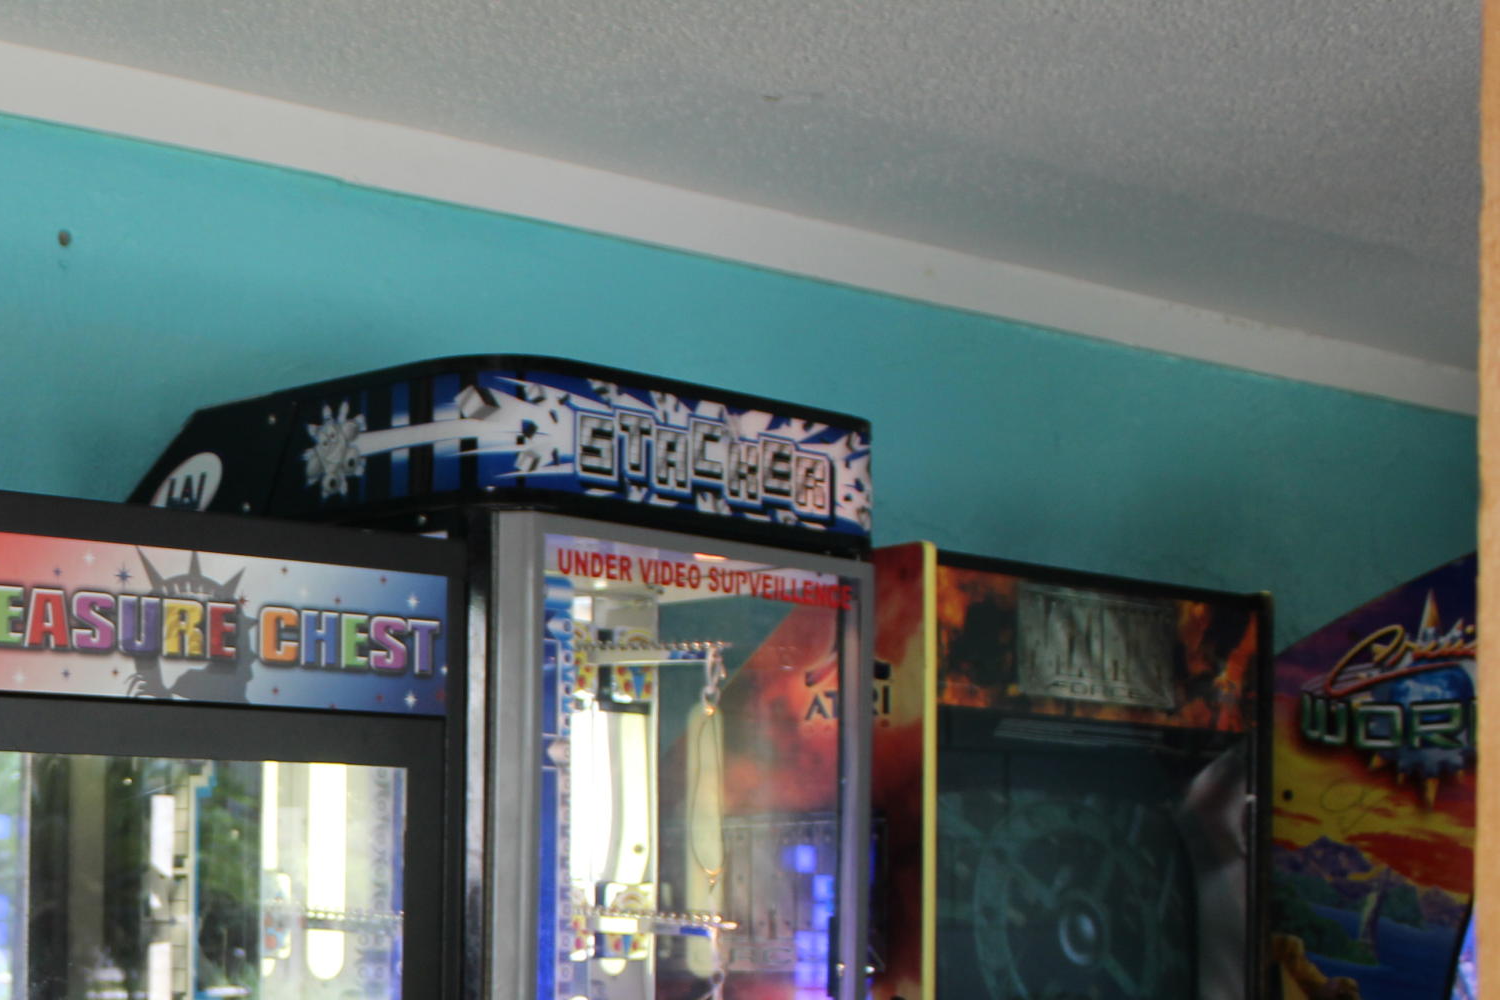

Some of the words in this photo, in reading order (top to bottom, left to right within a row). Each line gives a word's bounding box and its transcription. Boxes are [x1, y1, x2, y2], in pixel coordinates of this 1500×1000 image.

[577, 408, 834, 518] STACKER
[557, 548, 632, 581] UNDER
[639, 557, 702, 589] VIDEO
[260, 605, 441, 676] CHEST
[1299, 691, 1478, 749] WOR
